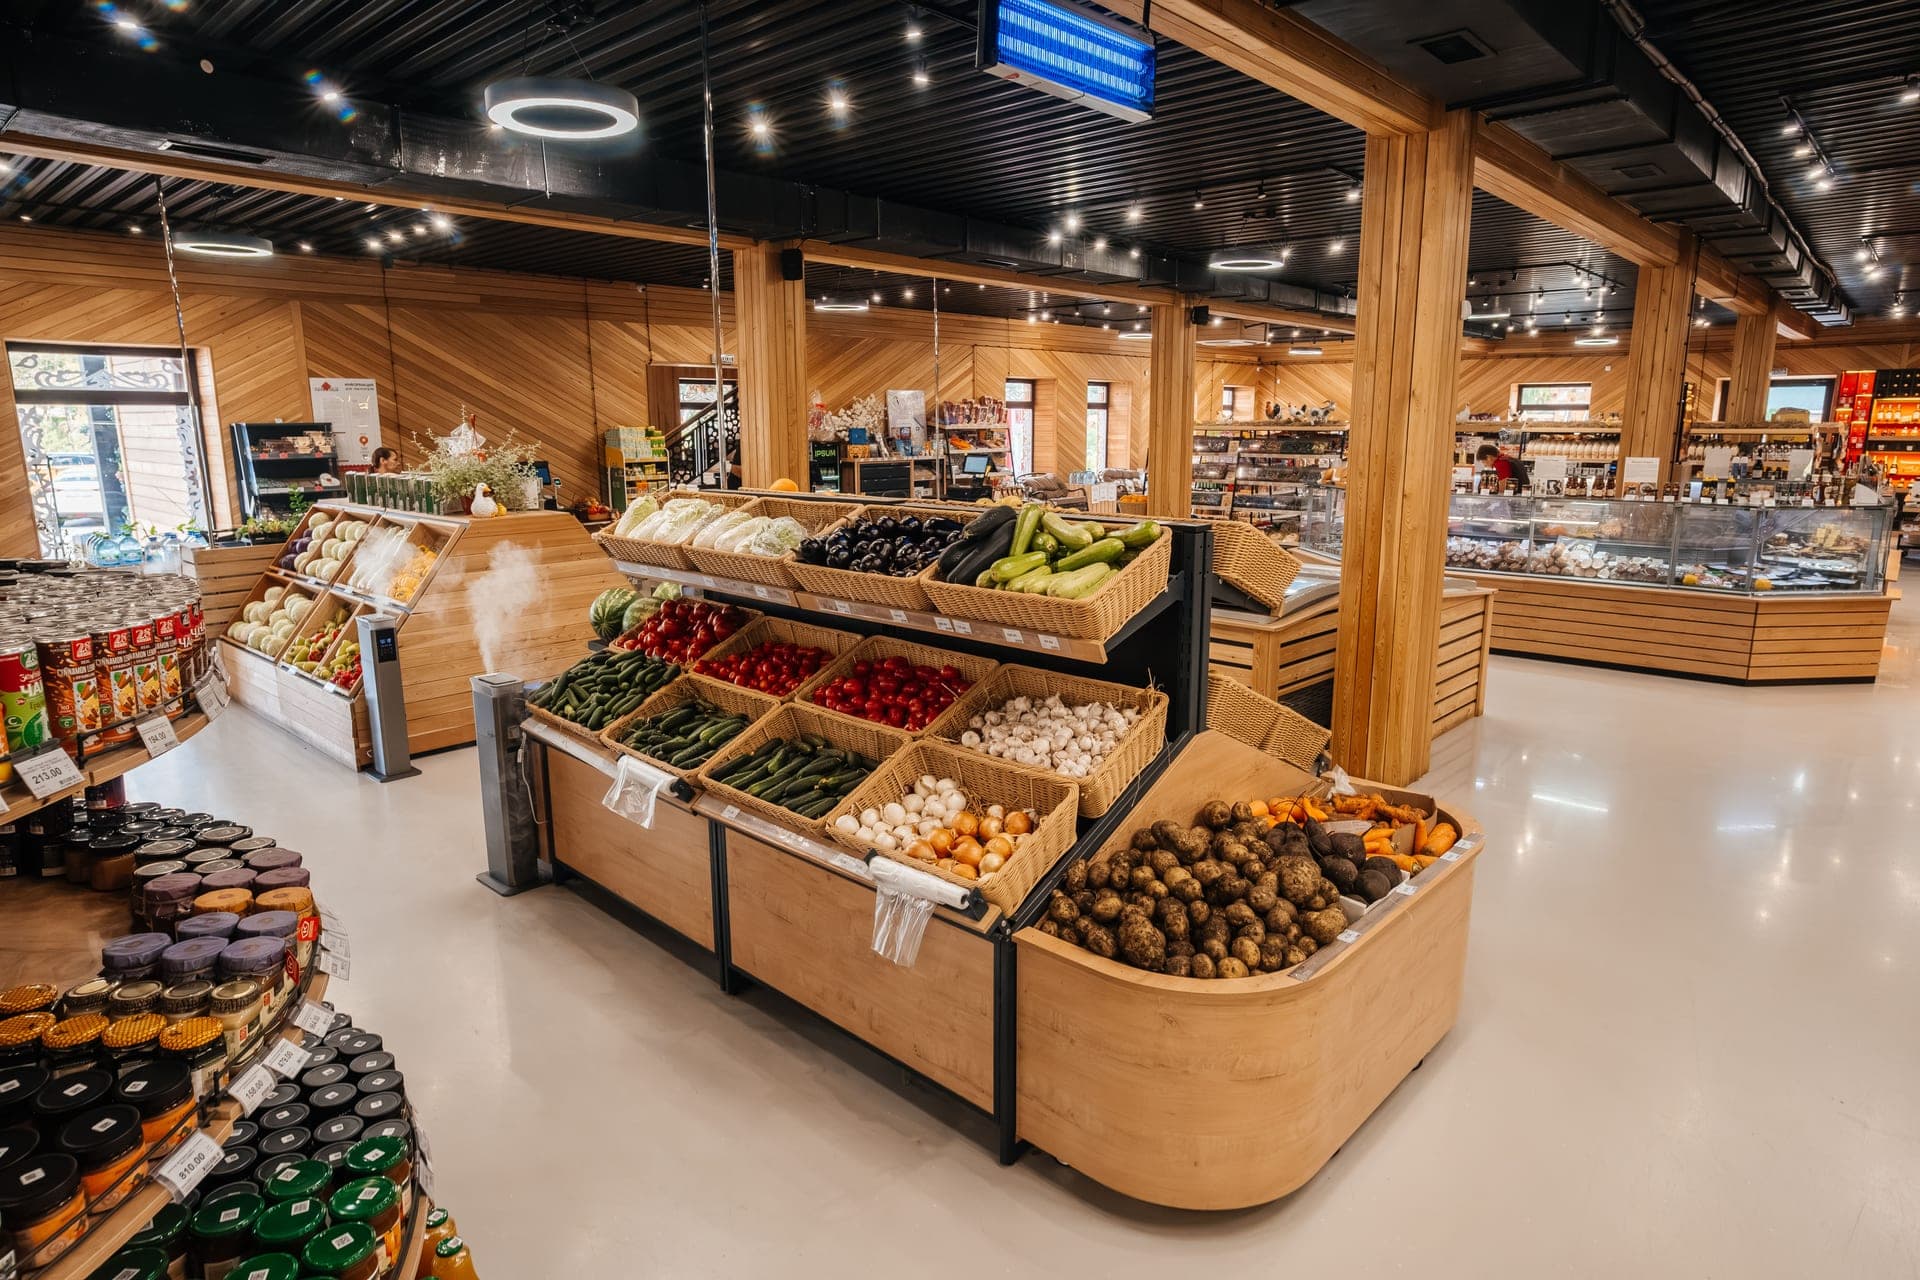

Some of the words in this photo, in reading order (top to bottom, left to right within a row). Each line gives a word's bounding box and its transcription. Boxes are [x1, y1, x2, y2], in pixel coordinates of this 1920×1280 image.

[815, 449, 836, 457] IPSUM
[32, 767, 62, 785] 213.00
[178, 1152, 205, 1180] 810.00
